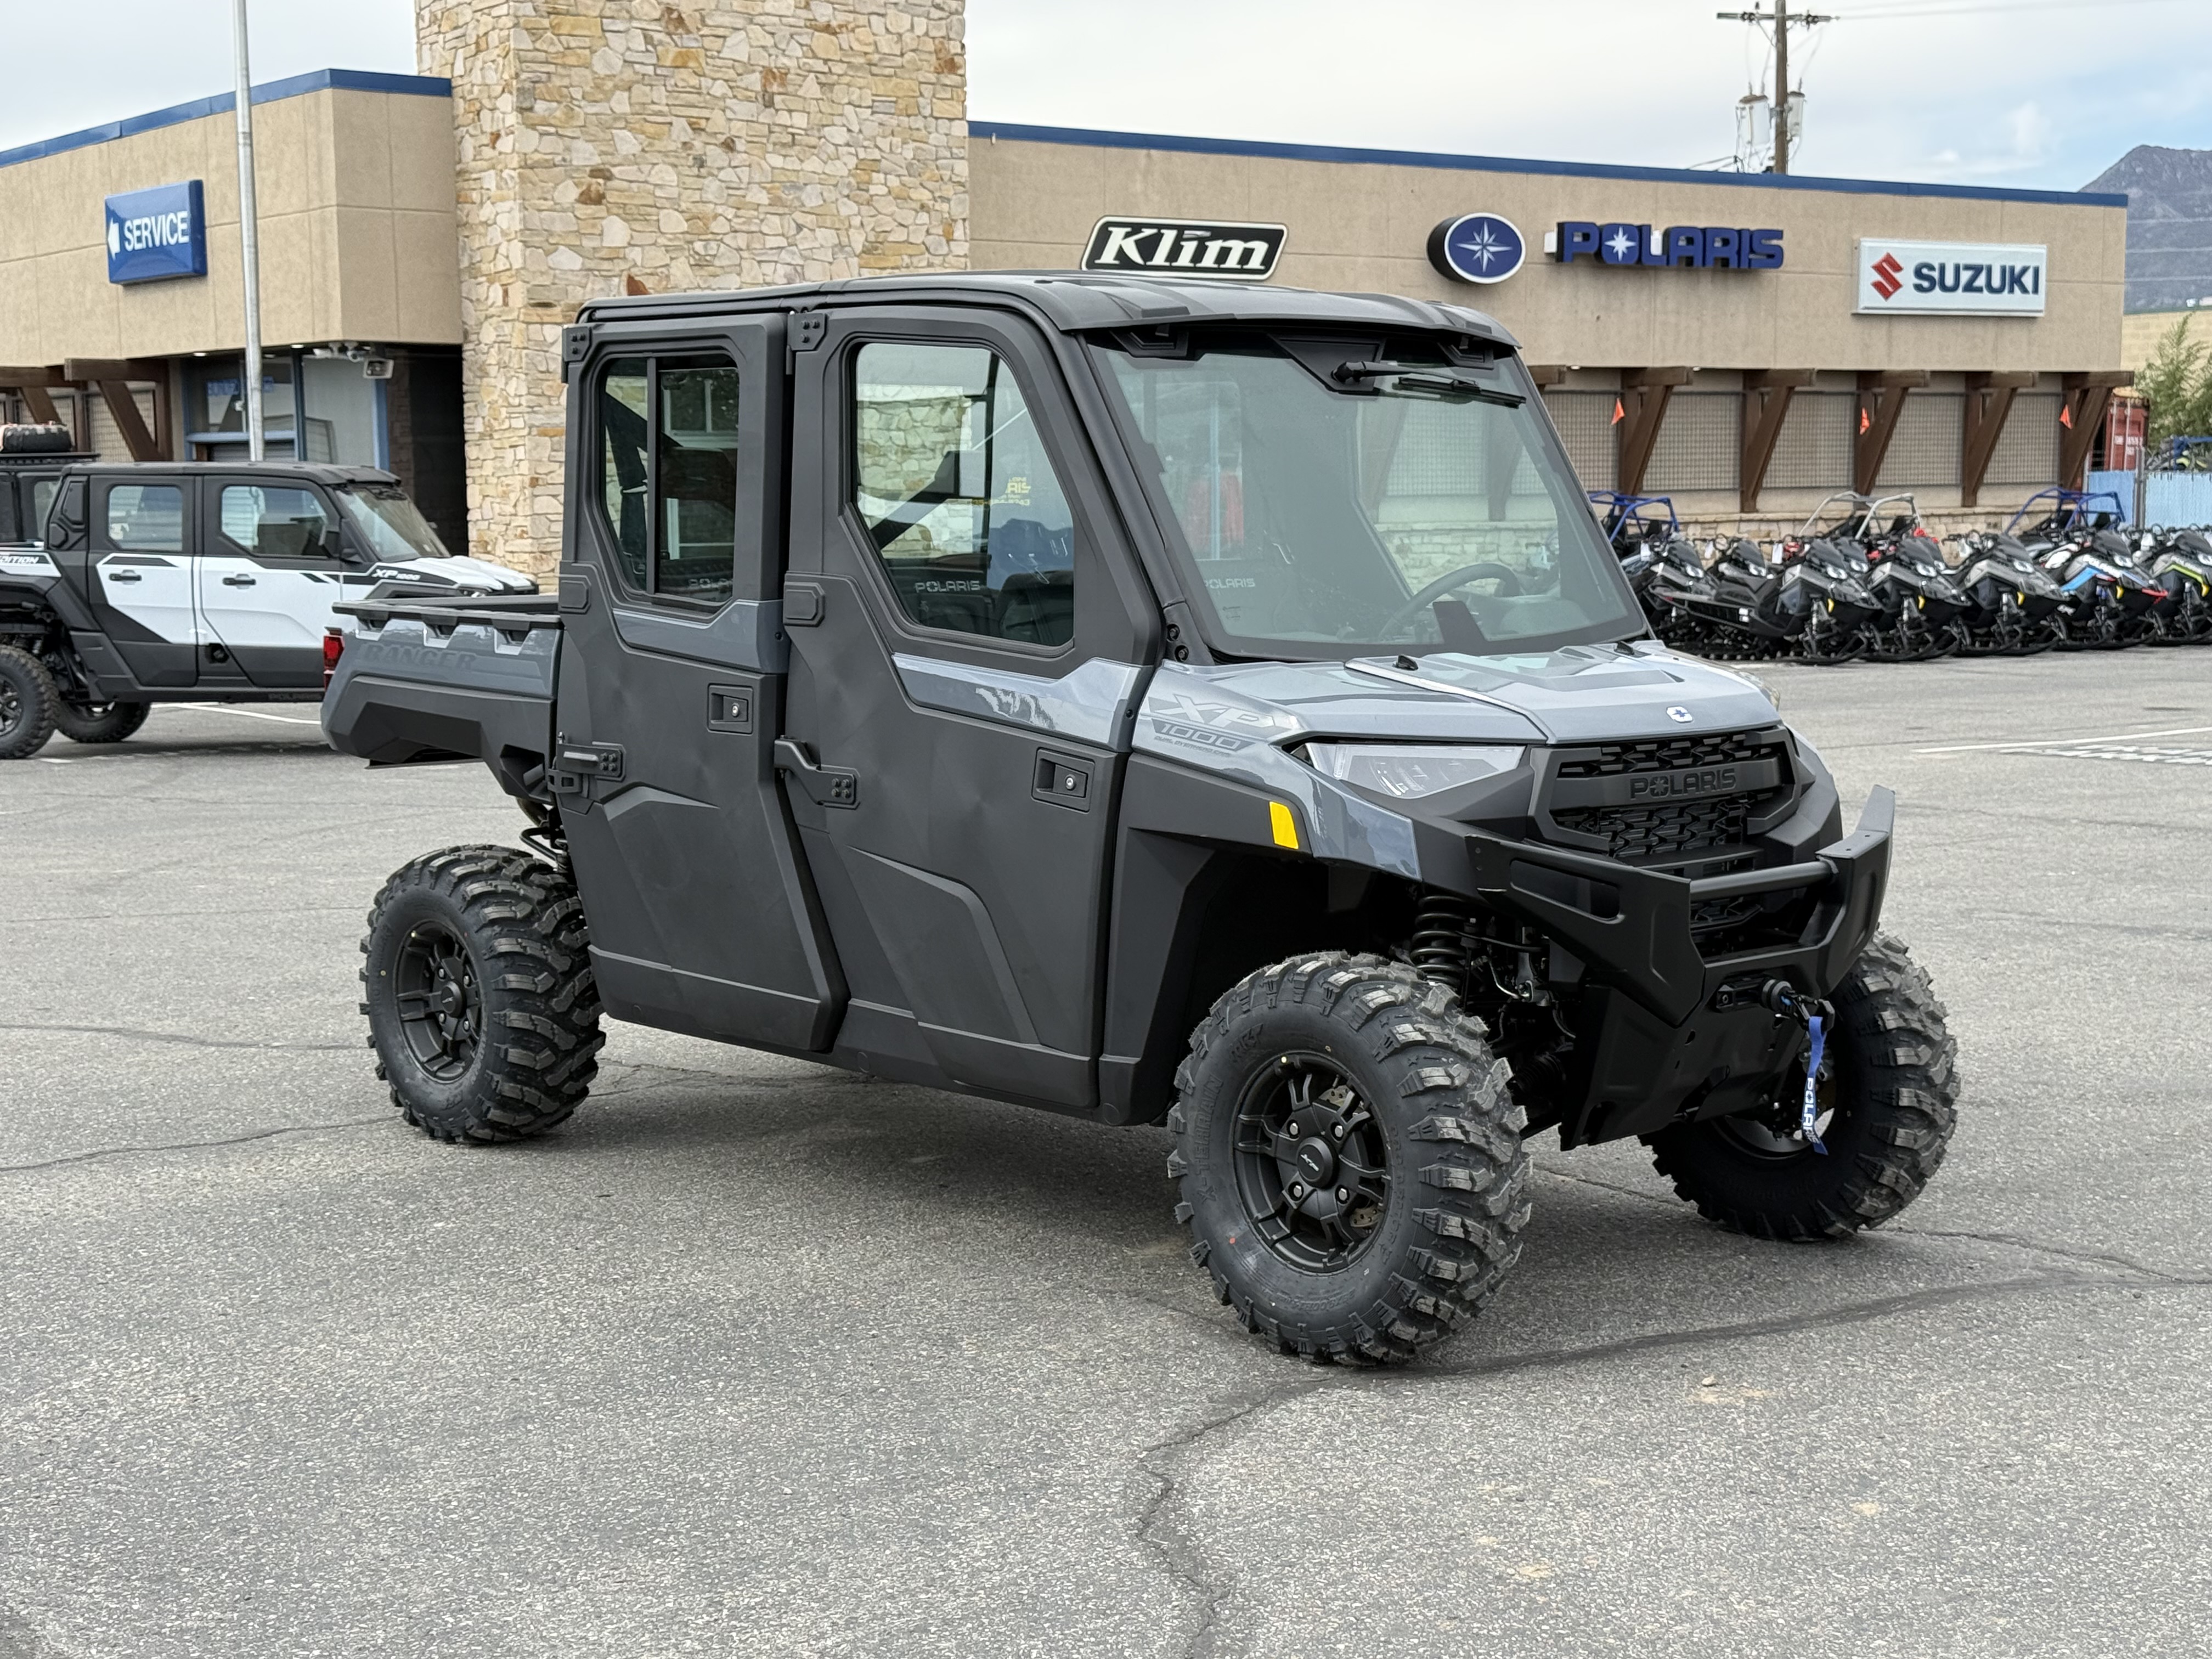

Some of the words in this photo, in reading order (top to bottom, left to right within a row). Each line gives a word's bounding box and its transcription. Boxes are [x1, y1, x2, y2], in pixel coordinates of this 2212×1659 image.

[124, 211, 190, 252] SERVICE
[1558, 222, 1784, 269] POLARIS
[1912, 261, 2040, 295] SUZUKI
[0, 555, 40, 564] DITION
[915, 580, 981, 592] POLARIS
[363, 642, 477, 670] RANGER
[1154, 693, 1276, 728] XP
[1161, 723, 1241, 750] 1000
[1630, 769, 1736, 800] POLARIS
[1803, 1077, 1820, 1145] POLARIS
[1194, 1073, 1224, 1204] X-TERRAIN
